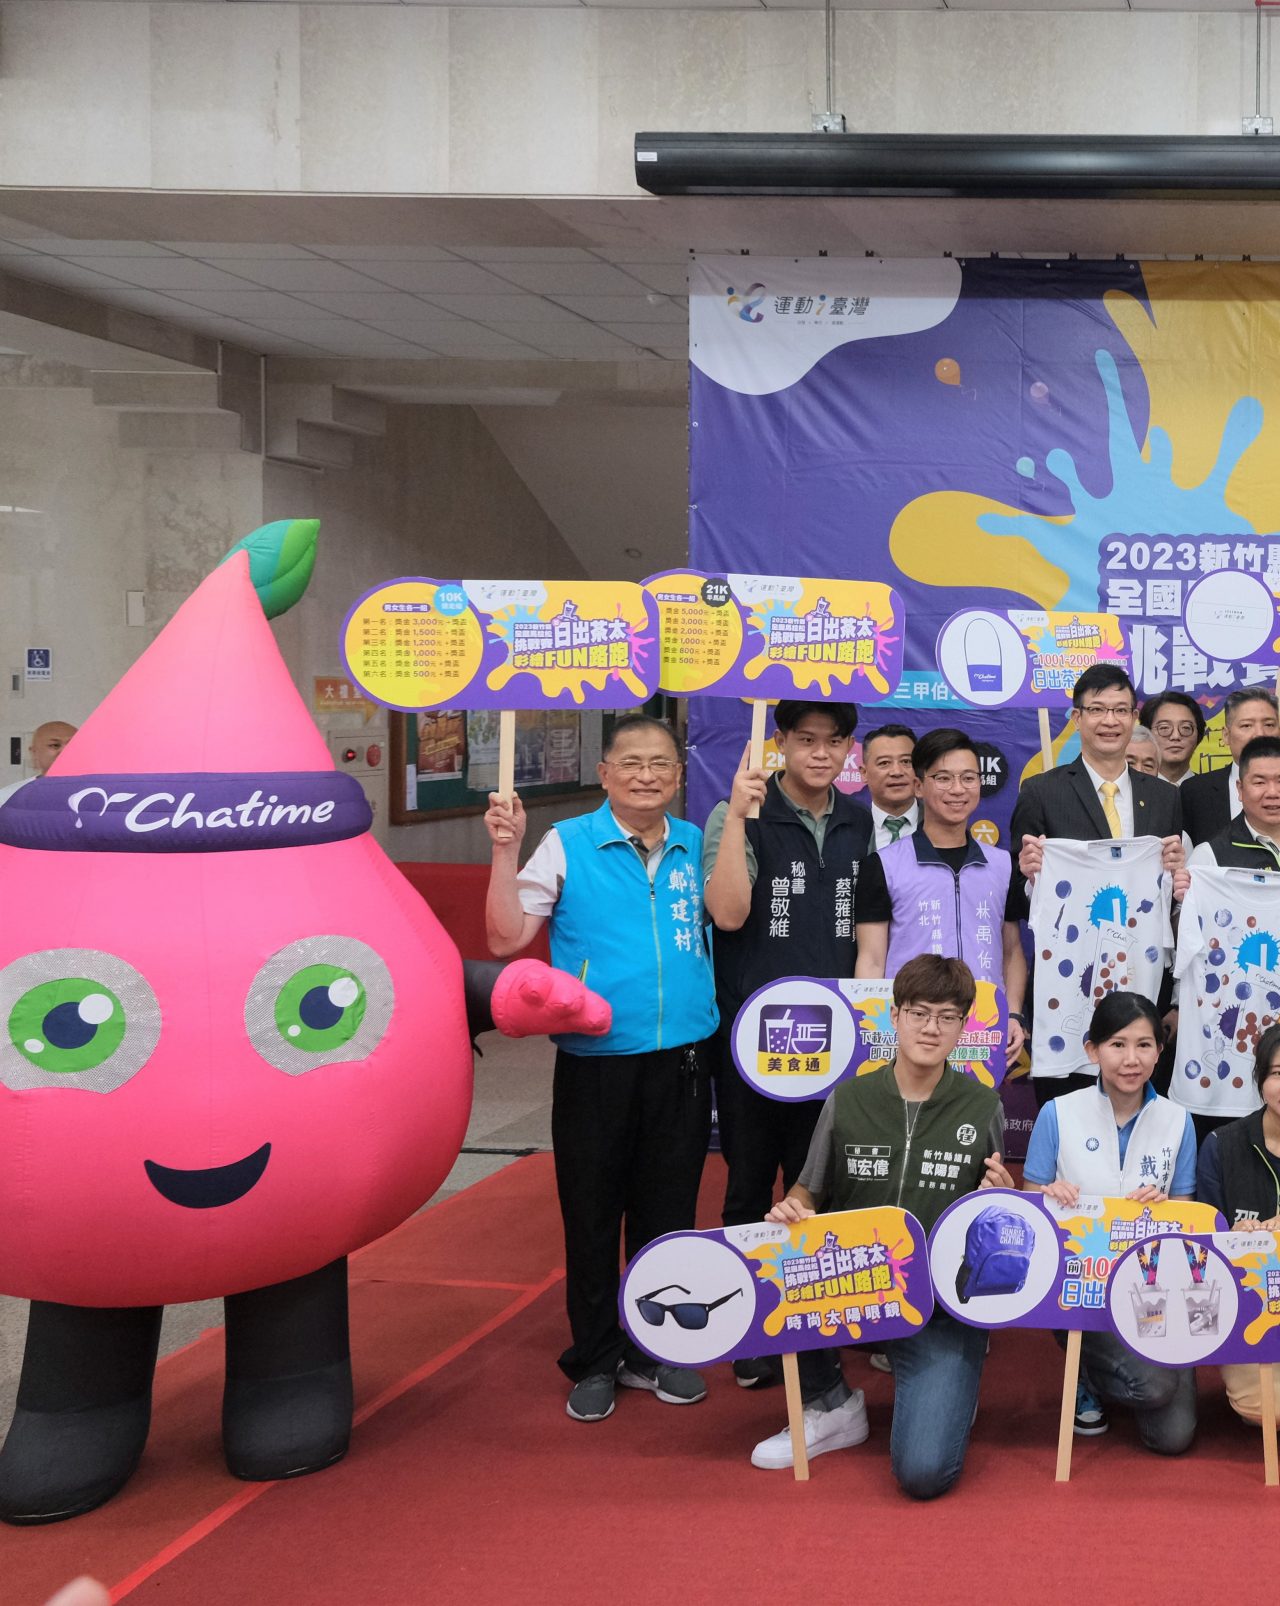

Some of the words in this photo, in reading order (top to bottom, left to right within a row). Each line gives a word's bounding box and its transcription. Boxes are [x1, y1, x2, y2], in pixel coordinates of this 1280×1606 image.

[440, 592, 463, 602] 10K
[706, 585, 728, 595] 21K
[1106, 579, 1197, 616] 全國
[555, 619, 627, 648] 日出茶太
[807, 617, 874, 642] 日出茶太
[514, 642, 628, 668] 彩繪FUN路跑
[769, 639, 874, 664] 彩繪FUN路跑
[894, 682, 960, 700] 三甲伯
[124, 790, 335, 833] Chatime
[791, 860, 806, 895] 秘書
[668, 868, 692, 952] 鄭建村
[769, 877, 790, 938] 曾敬維
[918, 900, 930, 927] 竹北
[767, 1057, 820, 1072] 美食通
[847, 1158, 889, 1177] 簡宏偉
[820, 1243, 886, 1278] 日出茶太
[785, 1270, 820, 1288] 挑戰賽
[786, 1265, 891, 1302] 彩繪FUN路跑
[1063, 1280, 1105, 1308] 日出
[787, 1302, 900, 1331] 時尚太陽眼鏡
